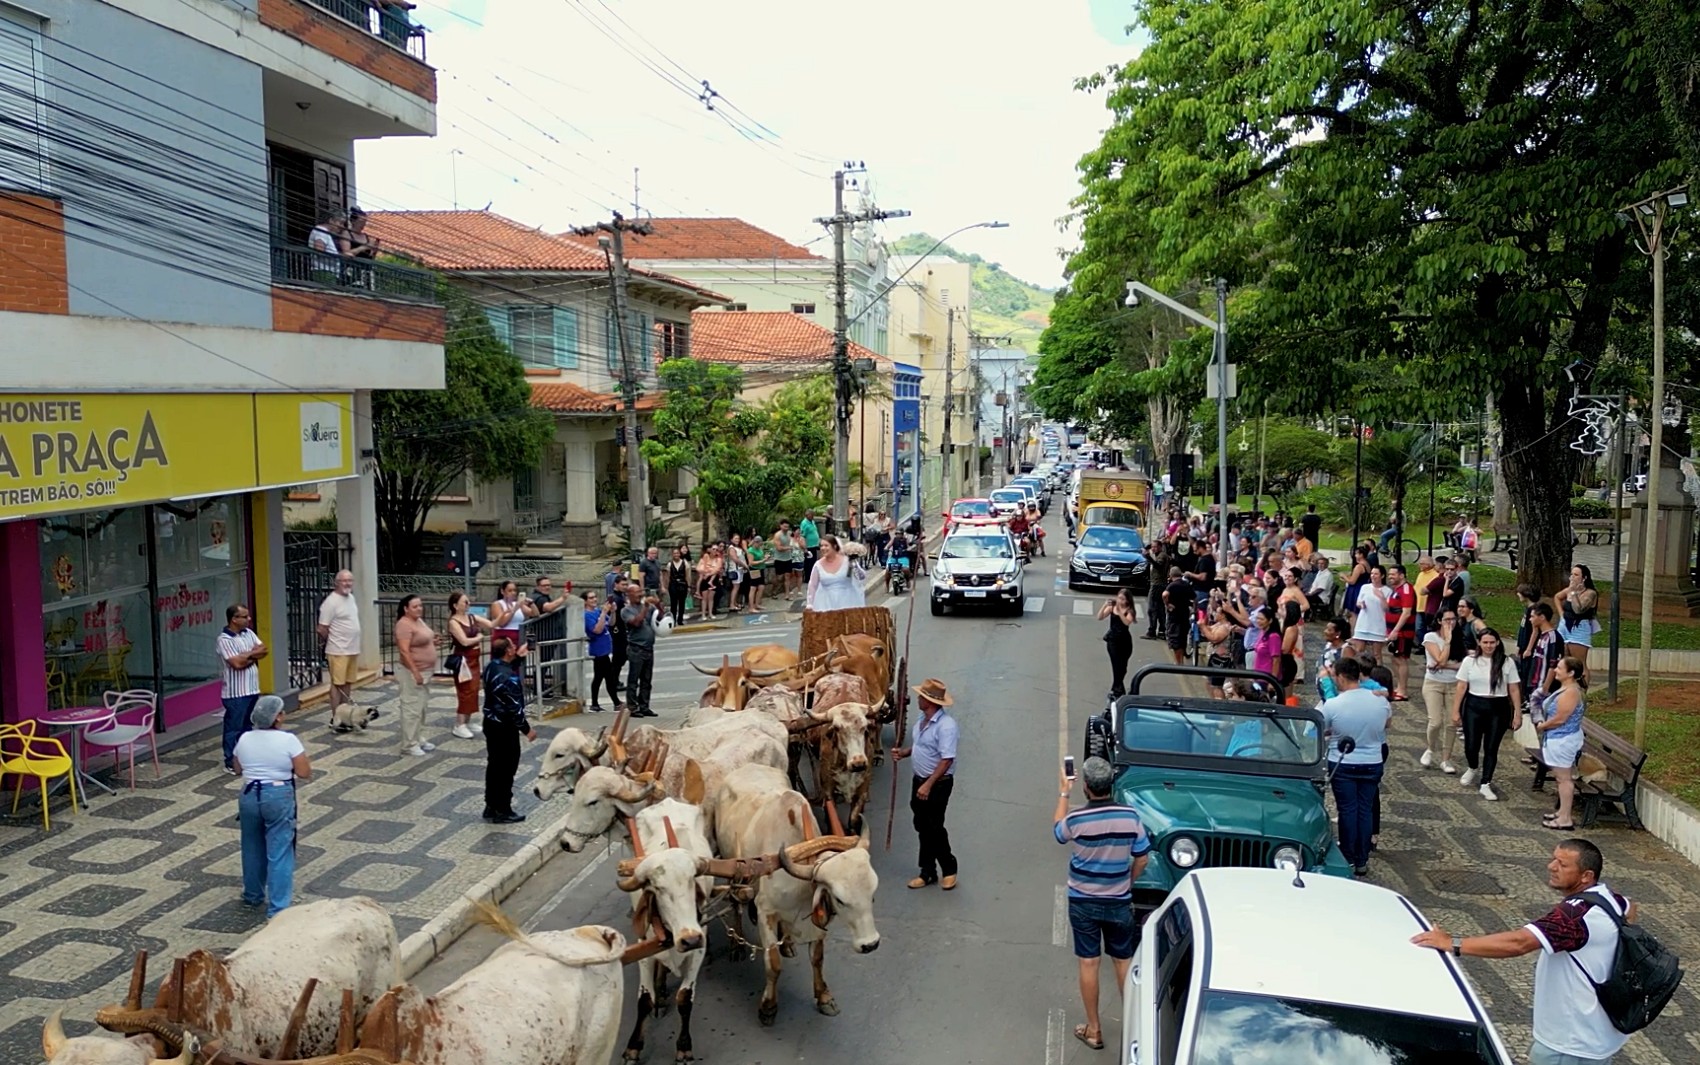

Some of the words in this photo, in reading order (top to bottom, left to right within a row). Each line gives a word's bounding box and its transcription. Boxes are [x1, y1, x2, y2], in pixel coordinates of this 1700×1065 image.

[32, 409, 168, 481] PRAÇA
[0, 487, 44, 506] TREM
[48, 481, 83, 500] BÃO,
[86, 478, 116, 497] SÔ!!!
